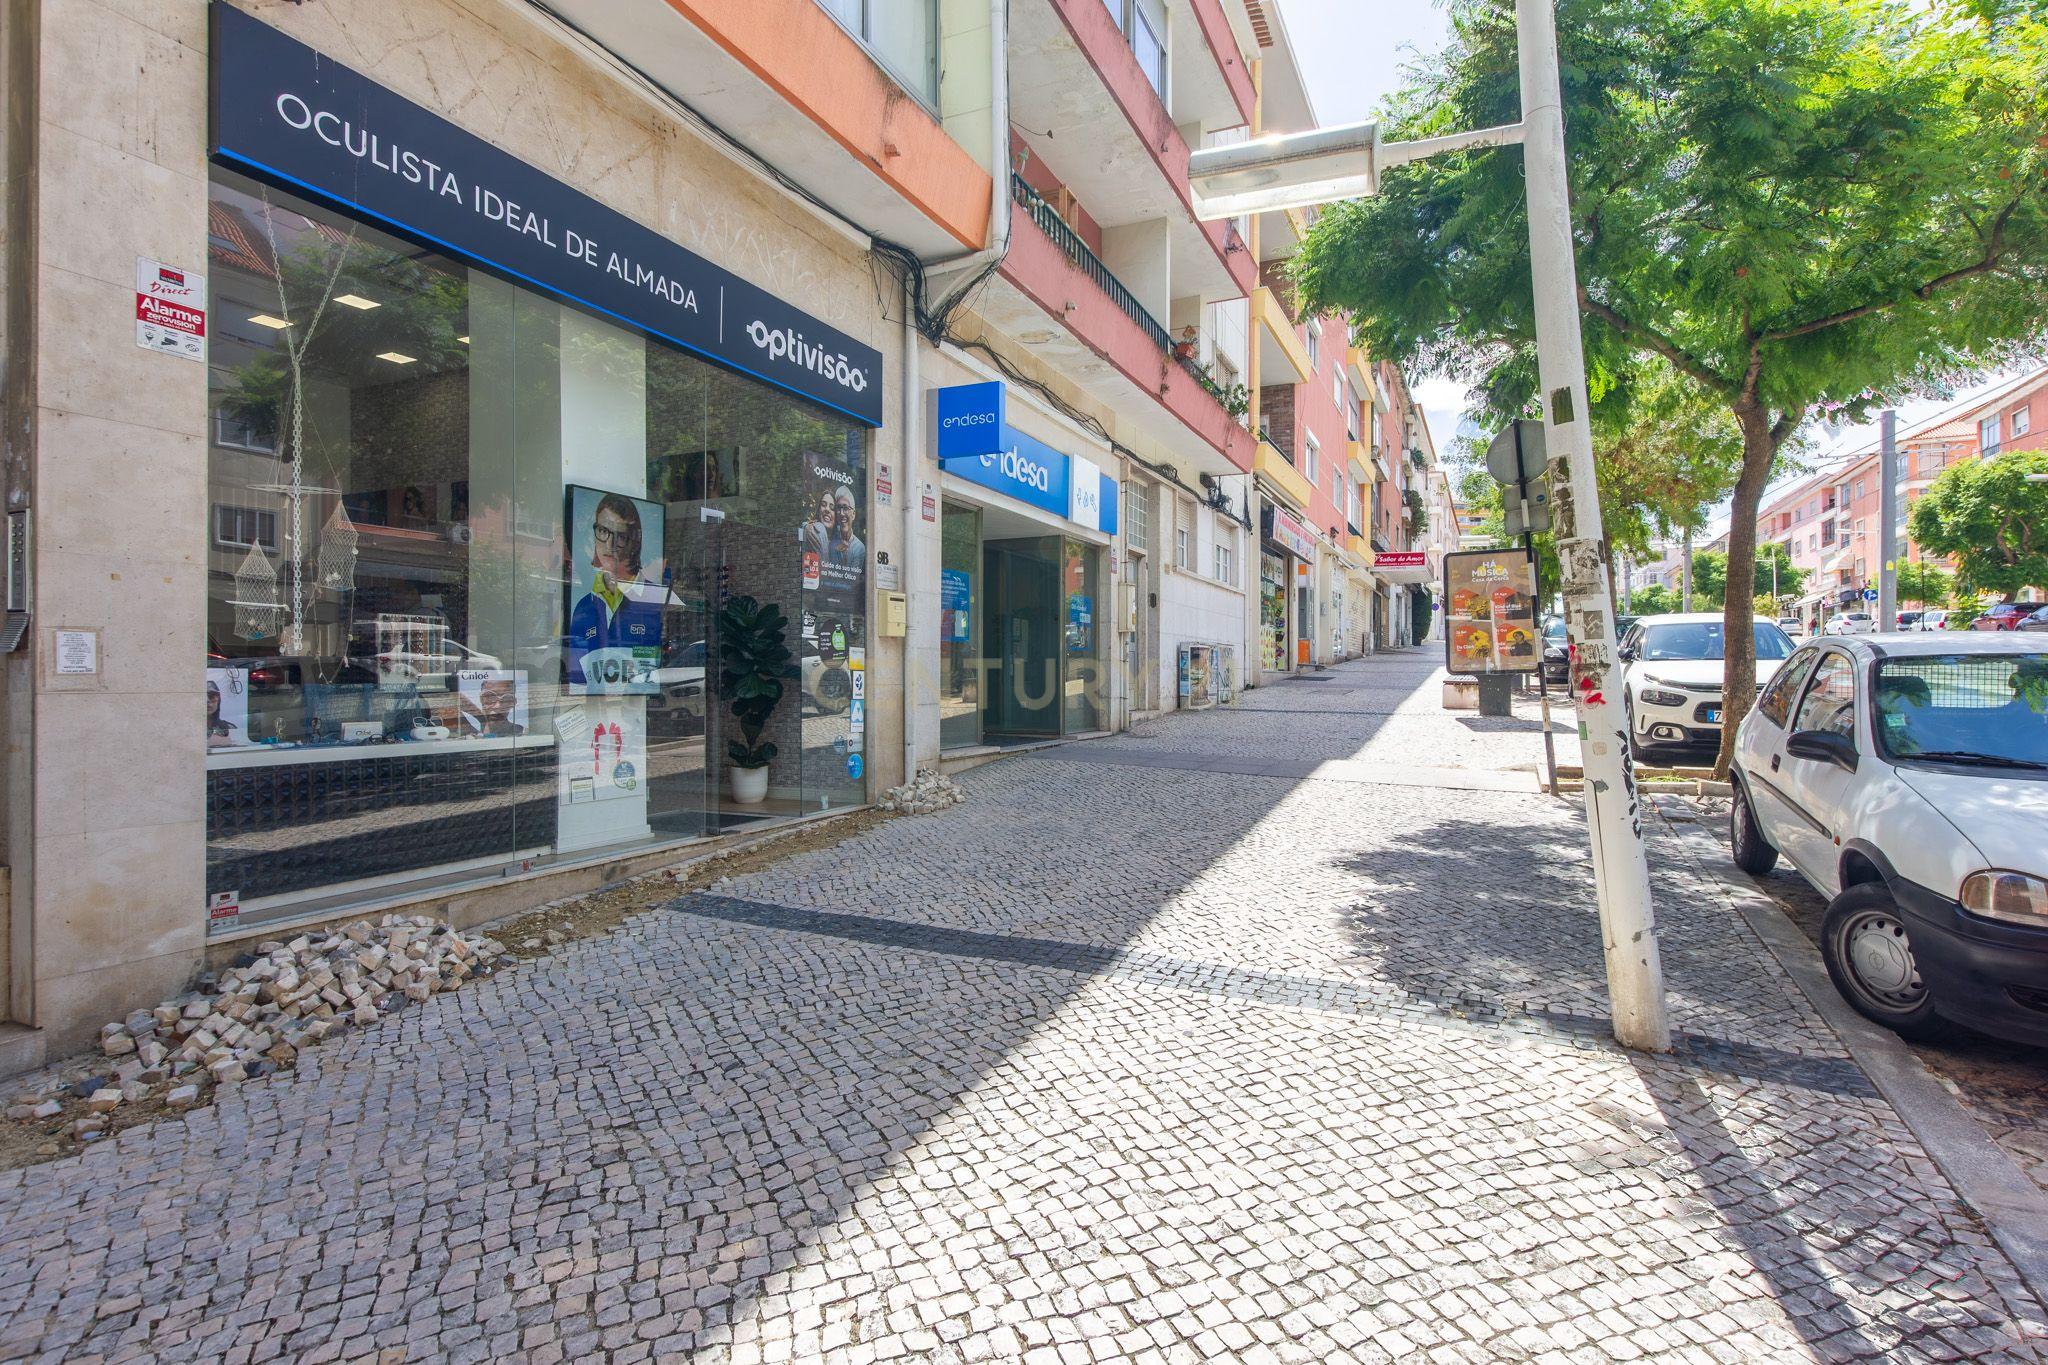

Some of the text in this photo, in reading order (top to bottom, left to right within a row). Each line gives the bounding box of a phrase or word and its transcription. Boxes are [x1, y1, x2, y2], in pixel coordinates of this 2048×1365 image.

[277, 93, 698, 314] OCULISTA IDEAL DE ALMADA
[150, 281, 196, 295] Direct
[140, 297, 202, 324] Alarme
[746, 320, 868, 392] optivisão
[943, 412, 995, 428] endesa
[814, 465, 854, 485] optivisão
[877, 551, 889, 565] 9B
